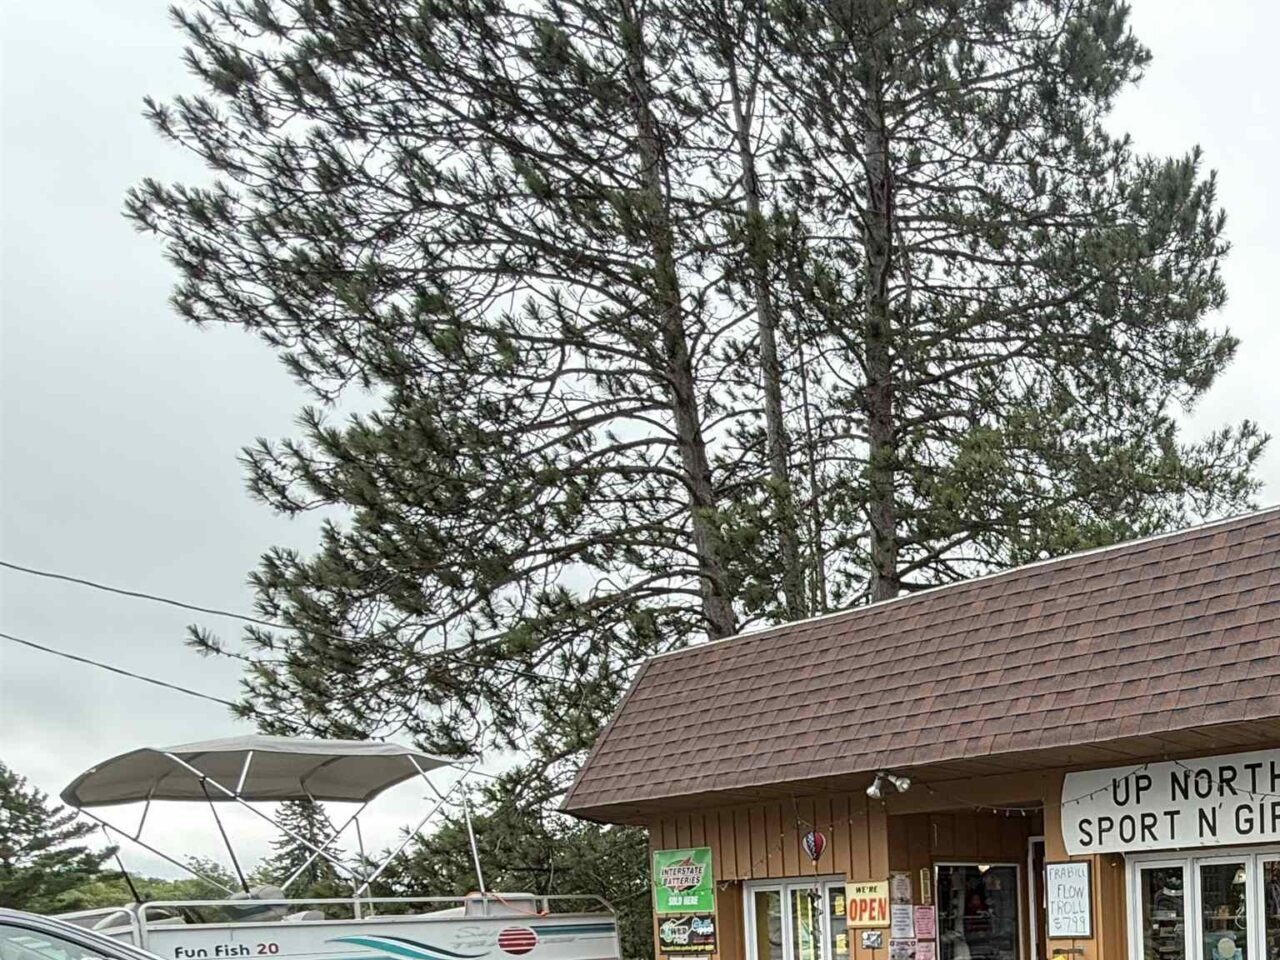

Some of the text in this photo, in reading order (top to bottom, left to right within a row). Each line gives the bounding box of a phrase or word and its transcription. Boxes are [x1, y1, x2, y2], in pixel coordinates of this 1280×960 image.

[1111, 773, 1152, 807] UP
[1078, 810, 1181, 847] SPORT
[661, 866, 703, 876] INTERSTATE
[662, 877, 701, 886] BATTERIES
[1057, 884, 1085, 899] FLOW
[849, 897, 887, 921] OPEN
[1050, 900, 1085, 914] TROLL
[174, 943, 280, 958] Fun Fish 20
